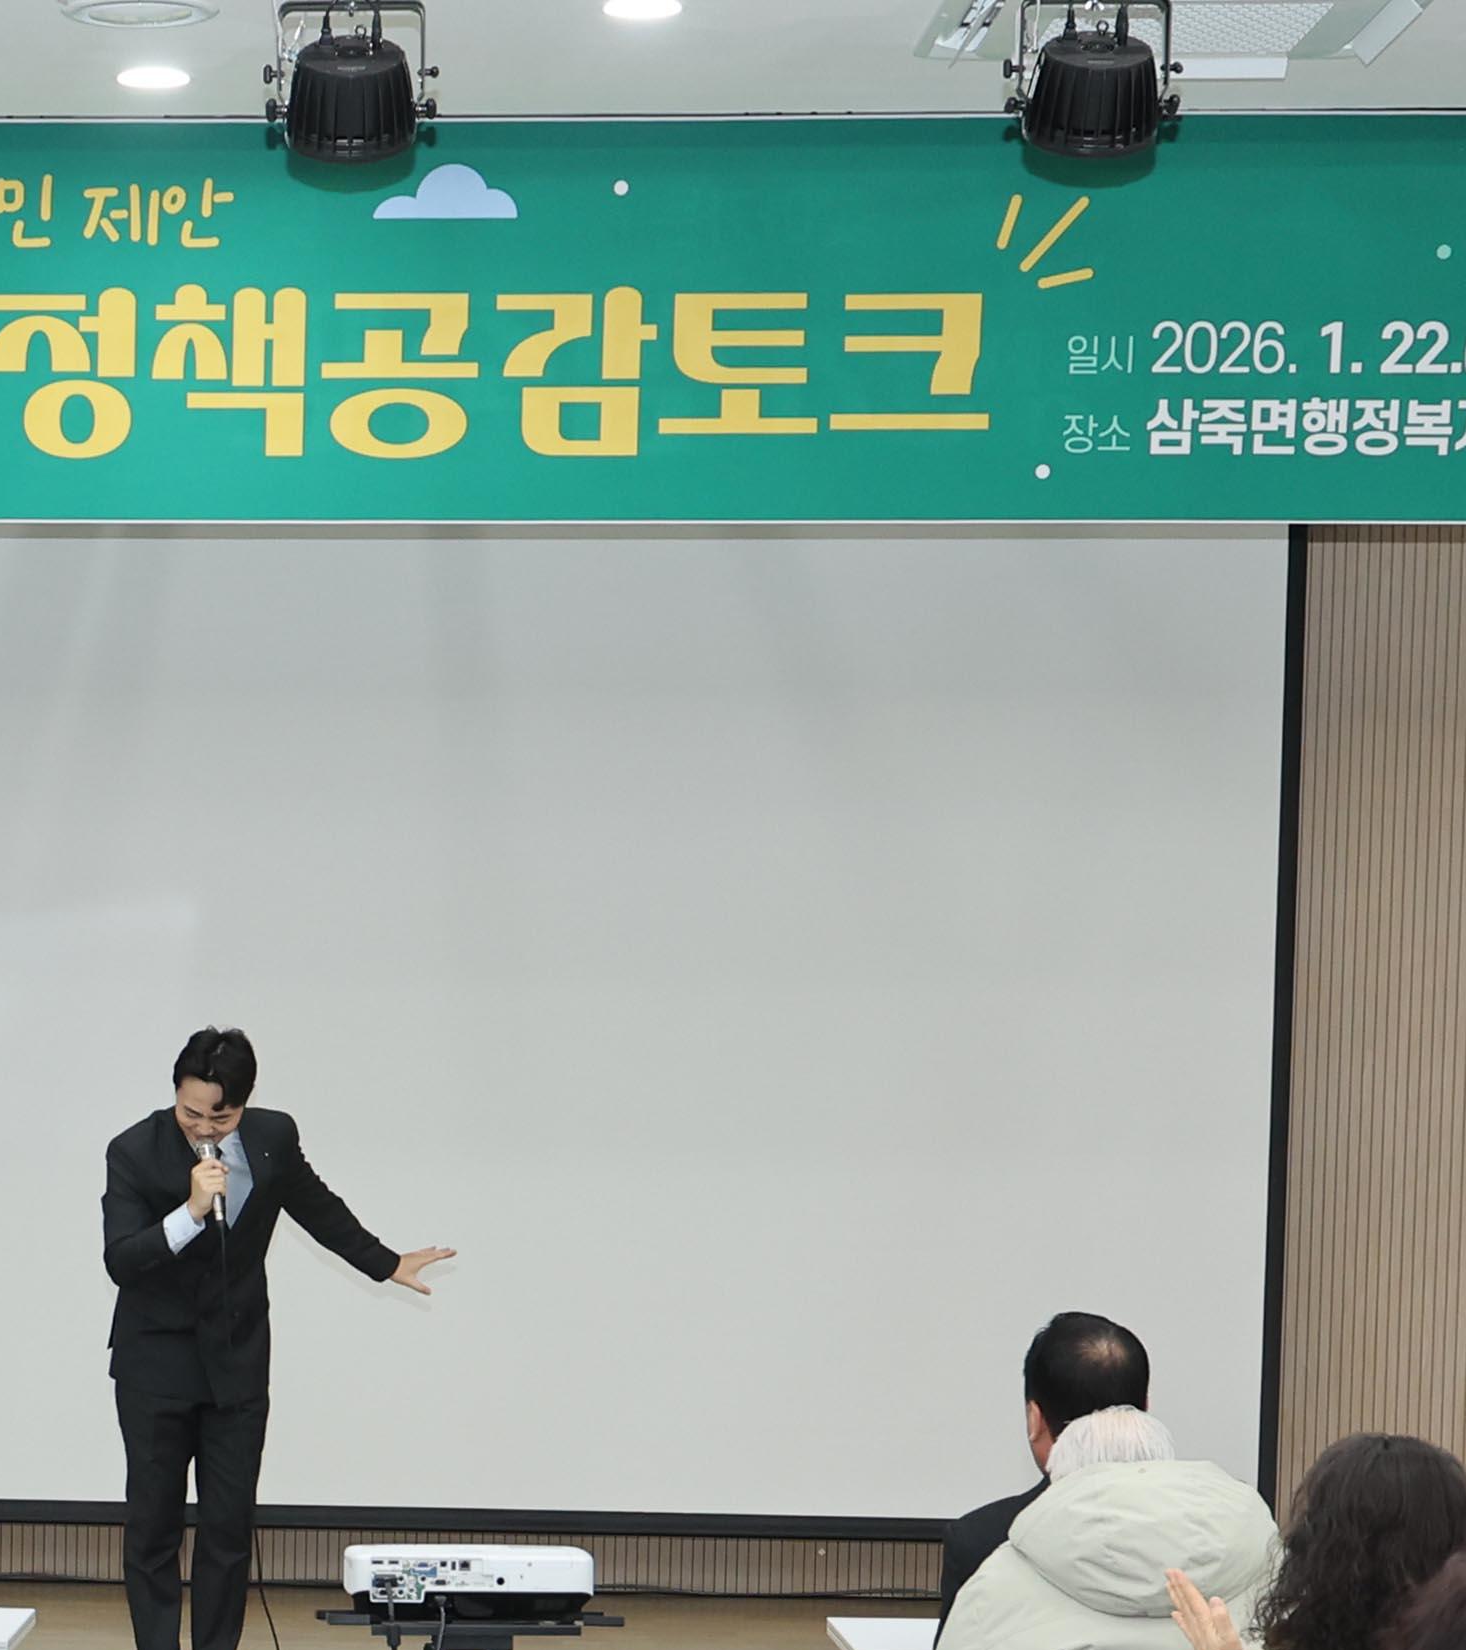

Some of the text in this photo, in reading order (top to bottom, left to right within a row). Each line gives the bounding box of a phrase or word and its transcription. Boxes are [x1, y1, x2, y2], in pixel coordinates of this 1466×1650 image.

[81, 177, 236, 250] 제안
[1067, 335, 1134, 375] 일시
[1150, 320, 1298, 375] 2026.
[1320, 321, 1364, 375] 1.
[1063, 414, 1131, 454] 장소
